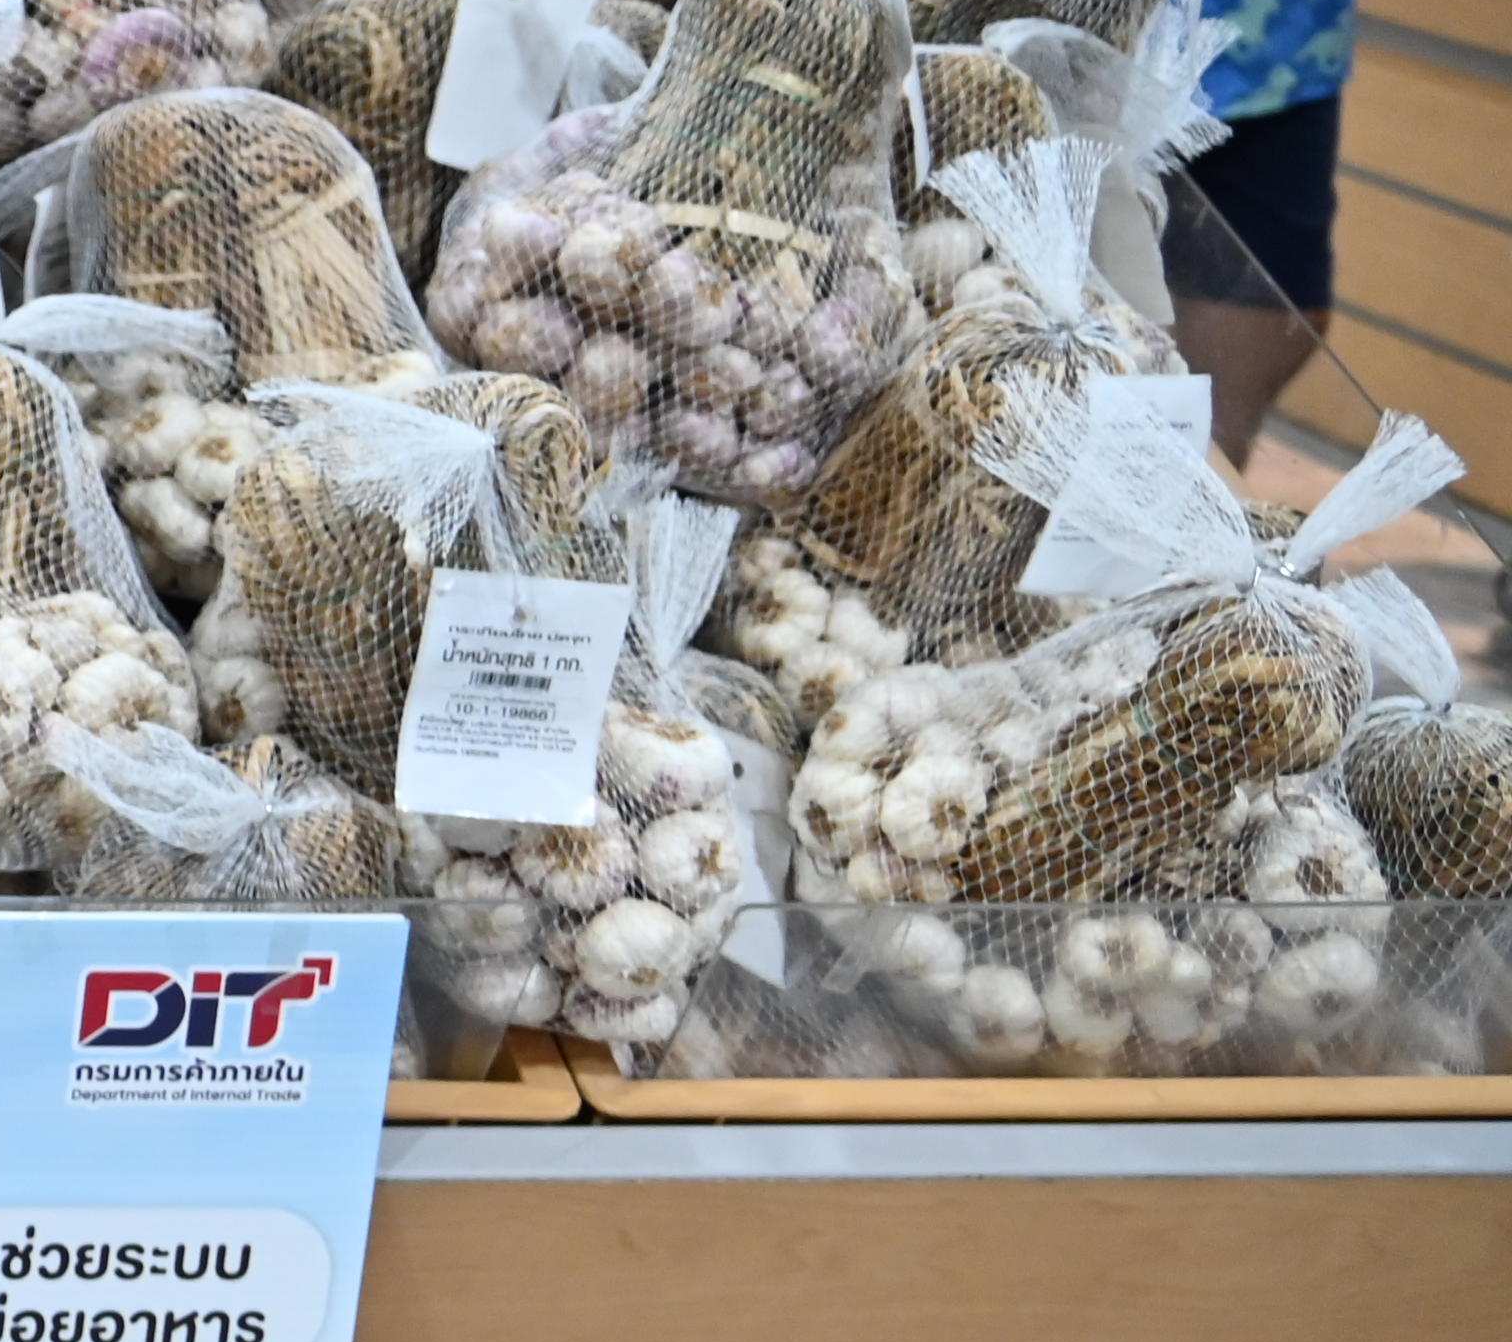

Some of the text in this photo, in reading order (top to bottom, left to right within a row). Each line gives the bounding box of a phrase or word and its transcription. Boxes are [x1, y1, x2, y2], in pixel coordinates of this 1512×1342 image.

[75, 1058, 305, 1083] กรมการค้าภายใน
[71, 1086, 301, 1103] Department of Internal Trade
[0, 1225, 252, 1281] ช่วยระบบ
